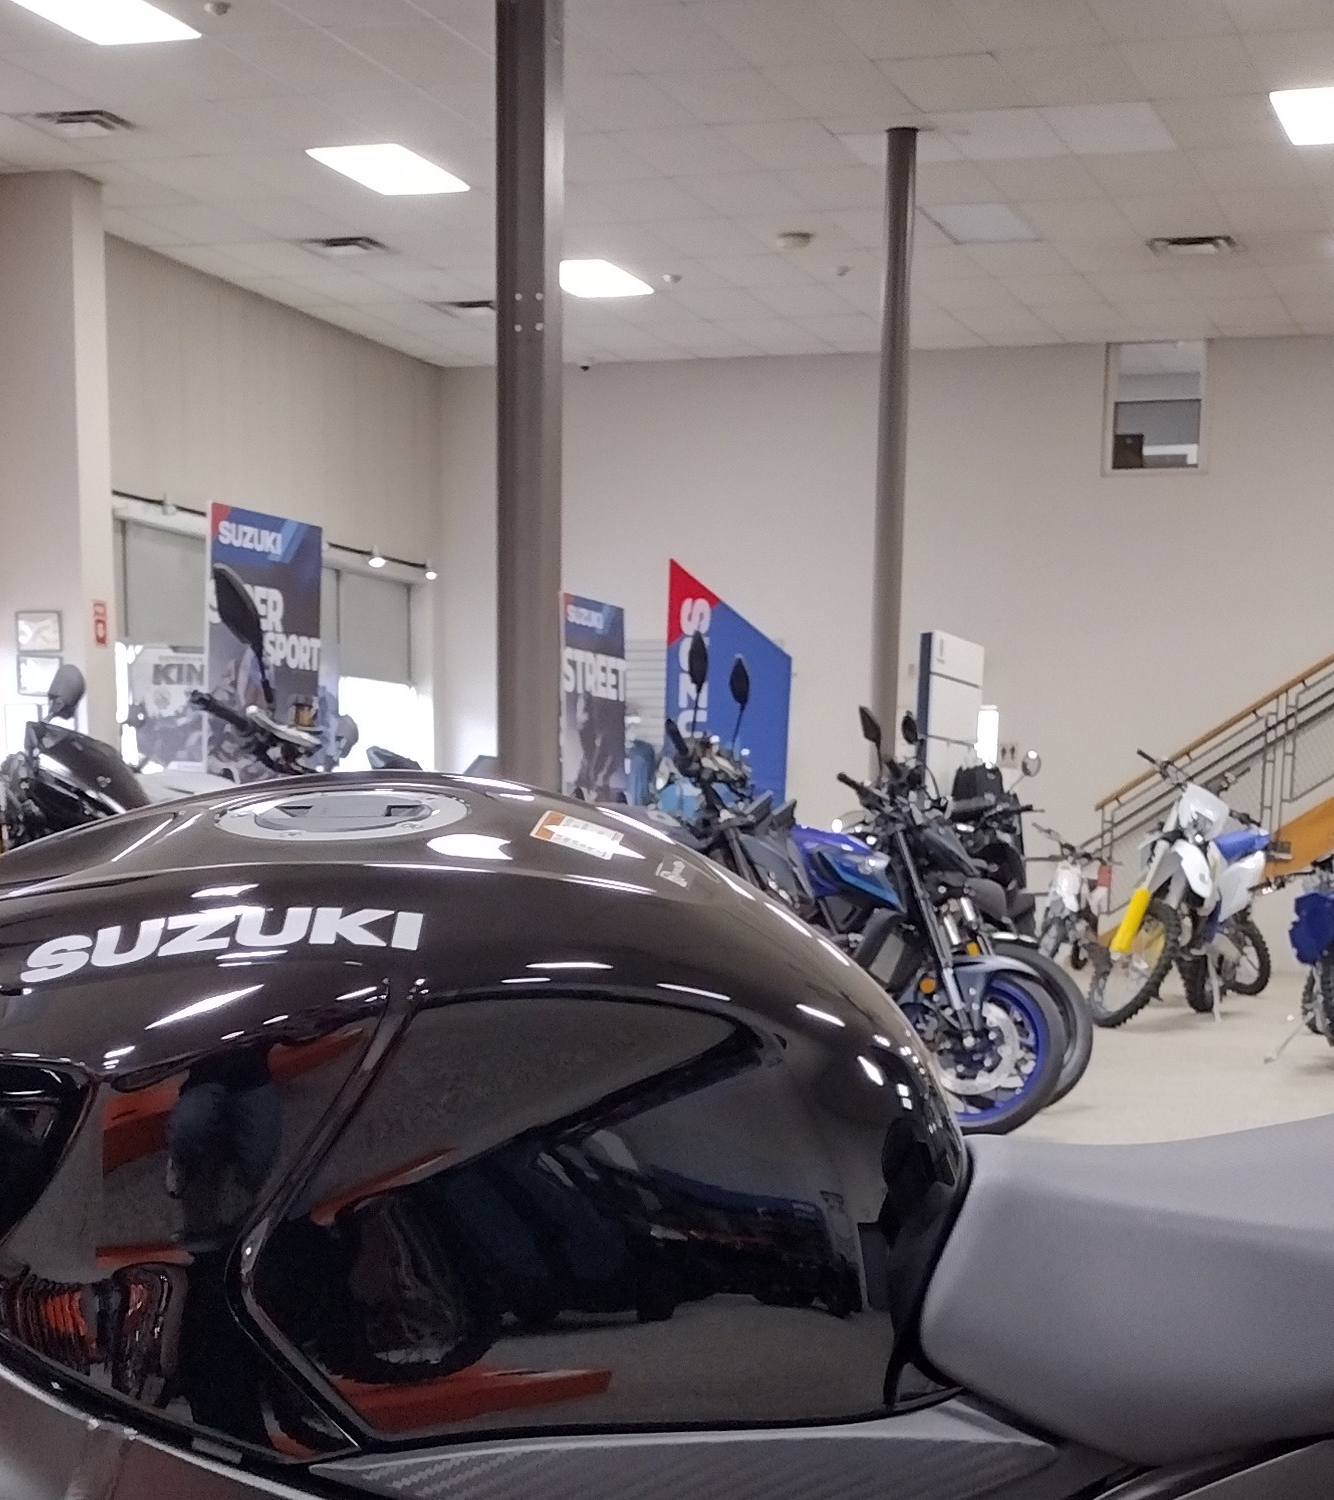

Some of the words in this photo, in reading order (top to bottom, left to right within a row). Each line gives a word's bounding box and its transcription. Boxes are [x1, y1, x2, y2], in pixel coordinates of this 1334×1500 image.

[218, 520, 284, 556] SUZUKI
[263, 631, 321, 672] SPORT
[152, 663, 204, 686] KIN
[563, 646, 626, 702] STREET
[20, 905, 424, 982] SUZUKI
